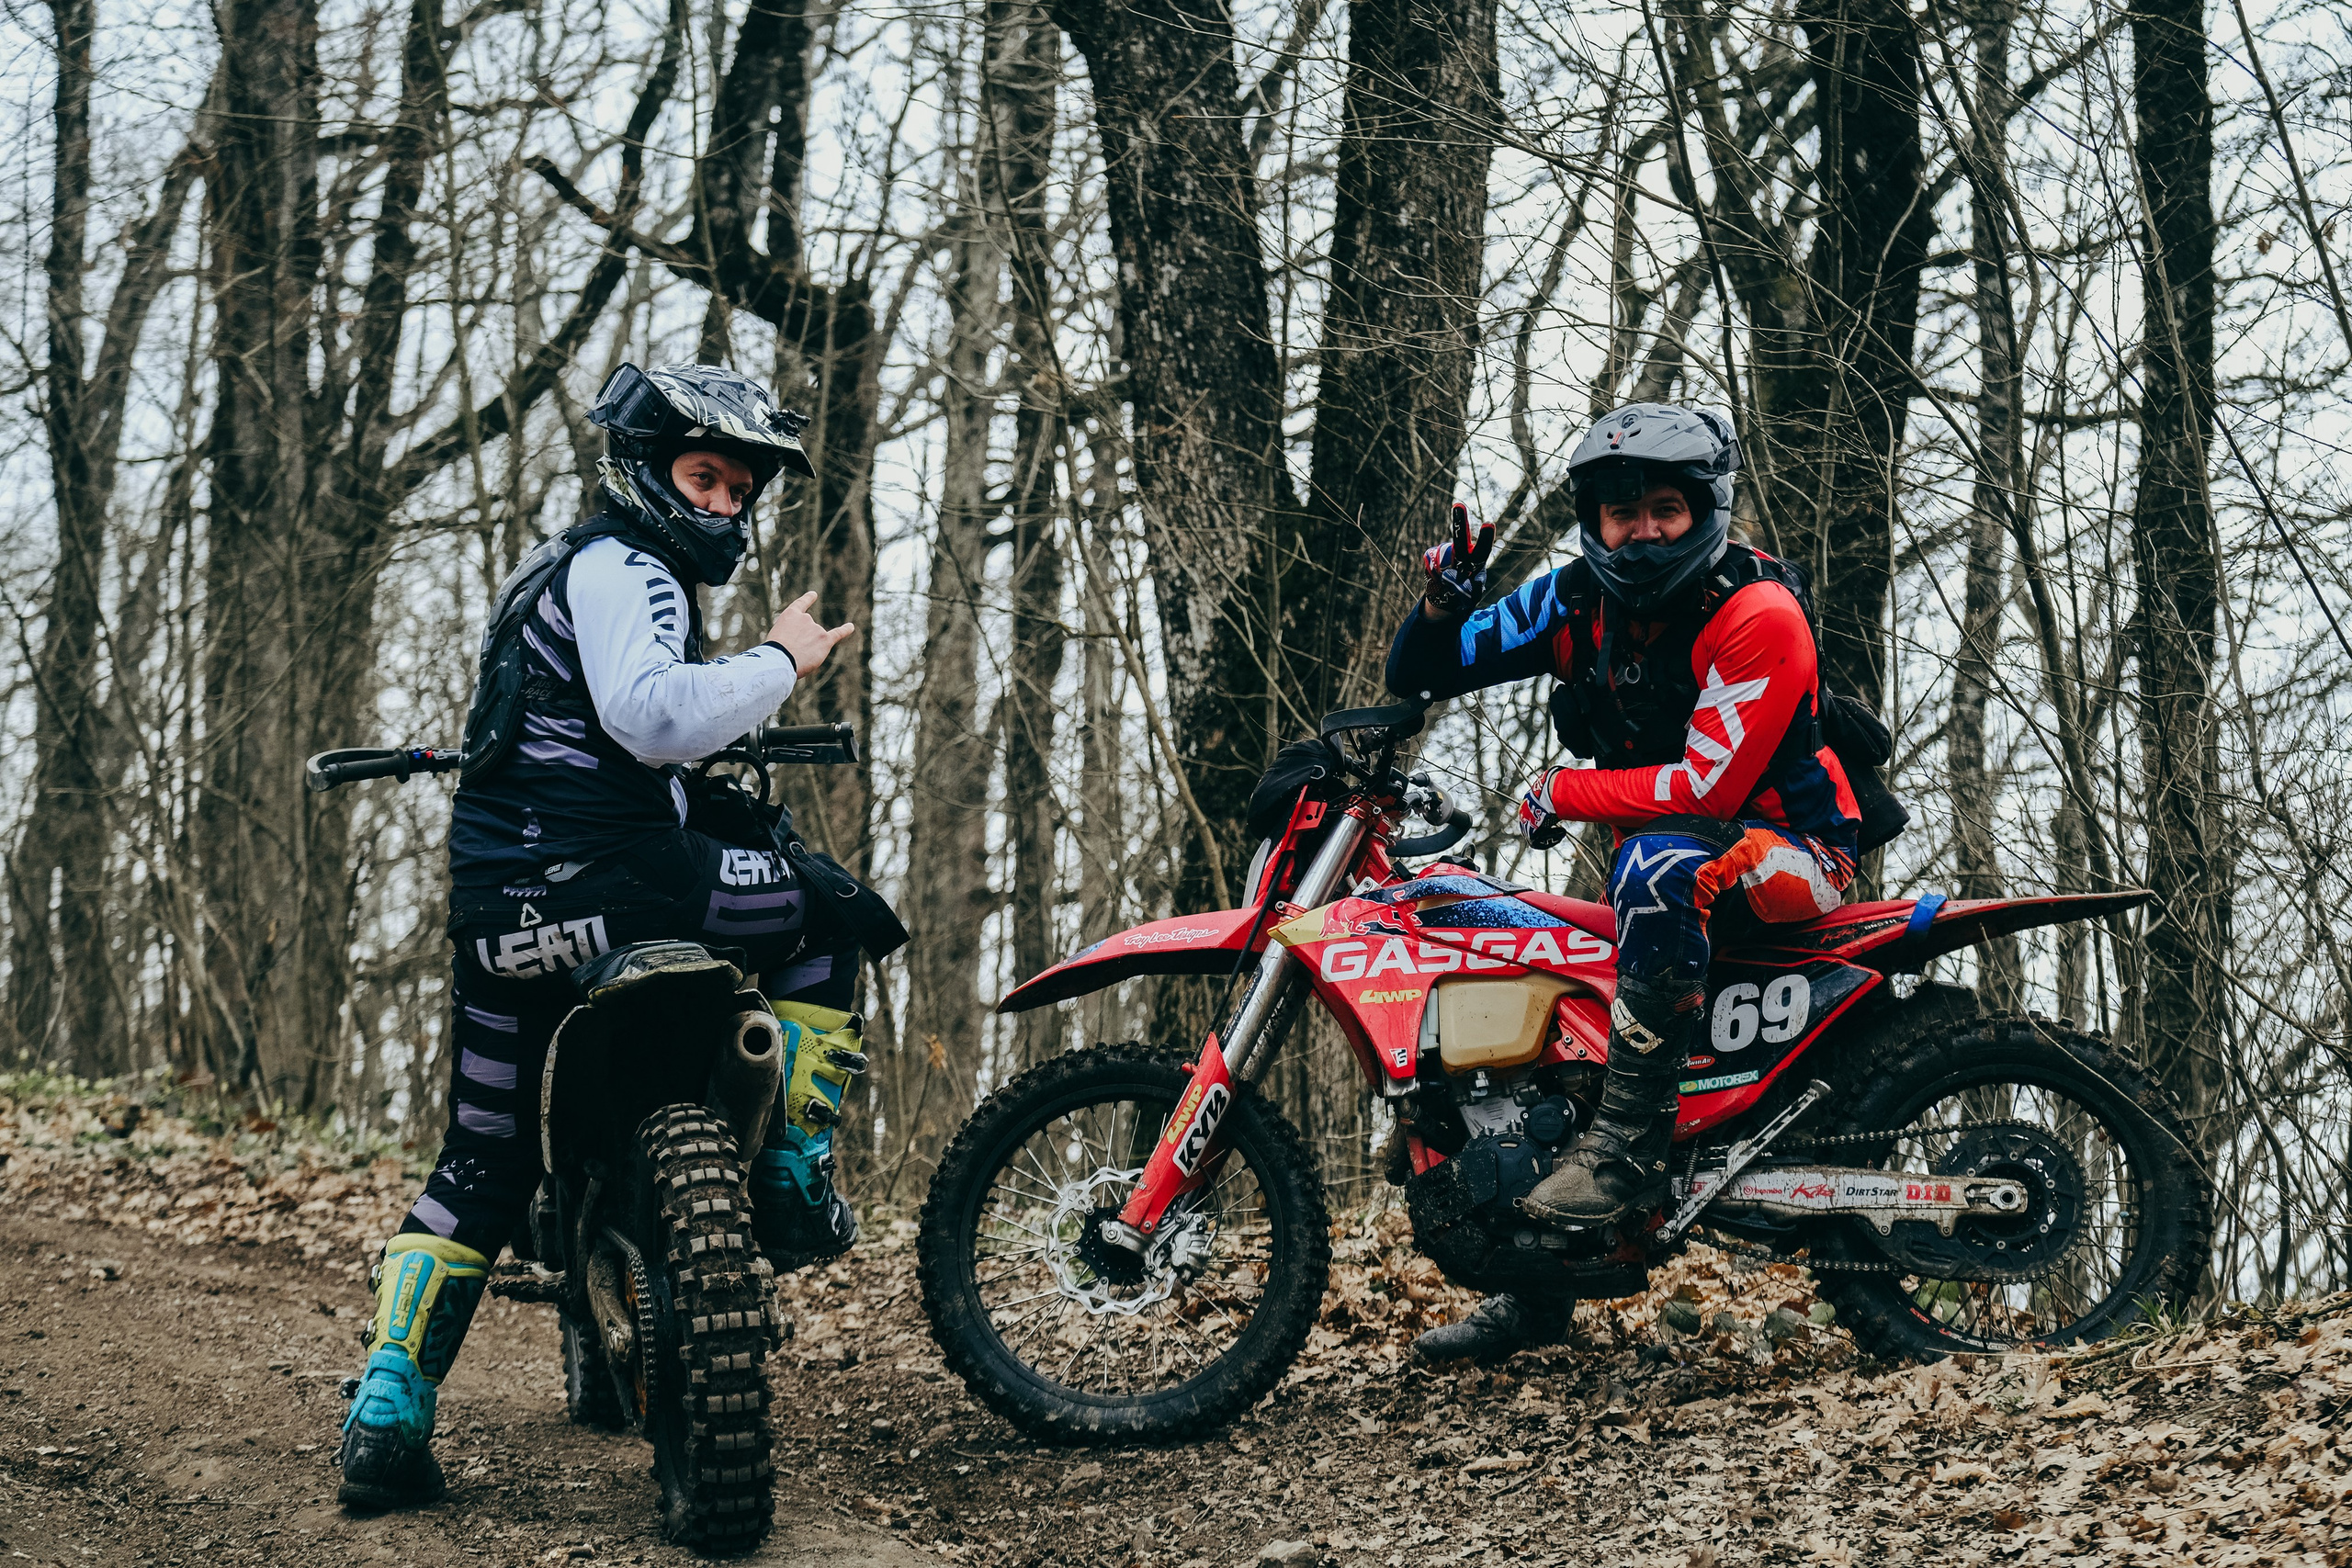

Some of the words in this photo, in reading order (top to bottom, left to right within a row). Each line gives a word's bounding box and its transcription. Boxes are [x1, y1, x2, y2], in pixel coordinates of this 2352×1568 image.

[525, 687, 556, 698] RACE
[1124, 933, 1150, 948] Troy
[1149, 931, 1171, 943] Lee
[1170, 927, 1220, 943] Designs
[1320, 930, 1612, 983] GASGAS
[1711, 974, 1810, 1053] 69
[1698, 1069, 1758, 1090] MOTOREX
[1177, 1088, 1228, 1175] KYB
[1754, 1183, 1783, 1195] brembo
[392, 1259, 424, 1329] TIGER
